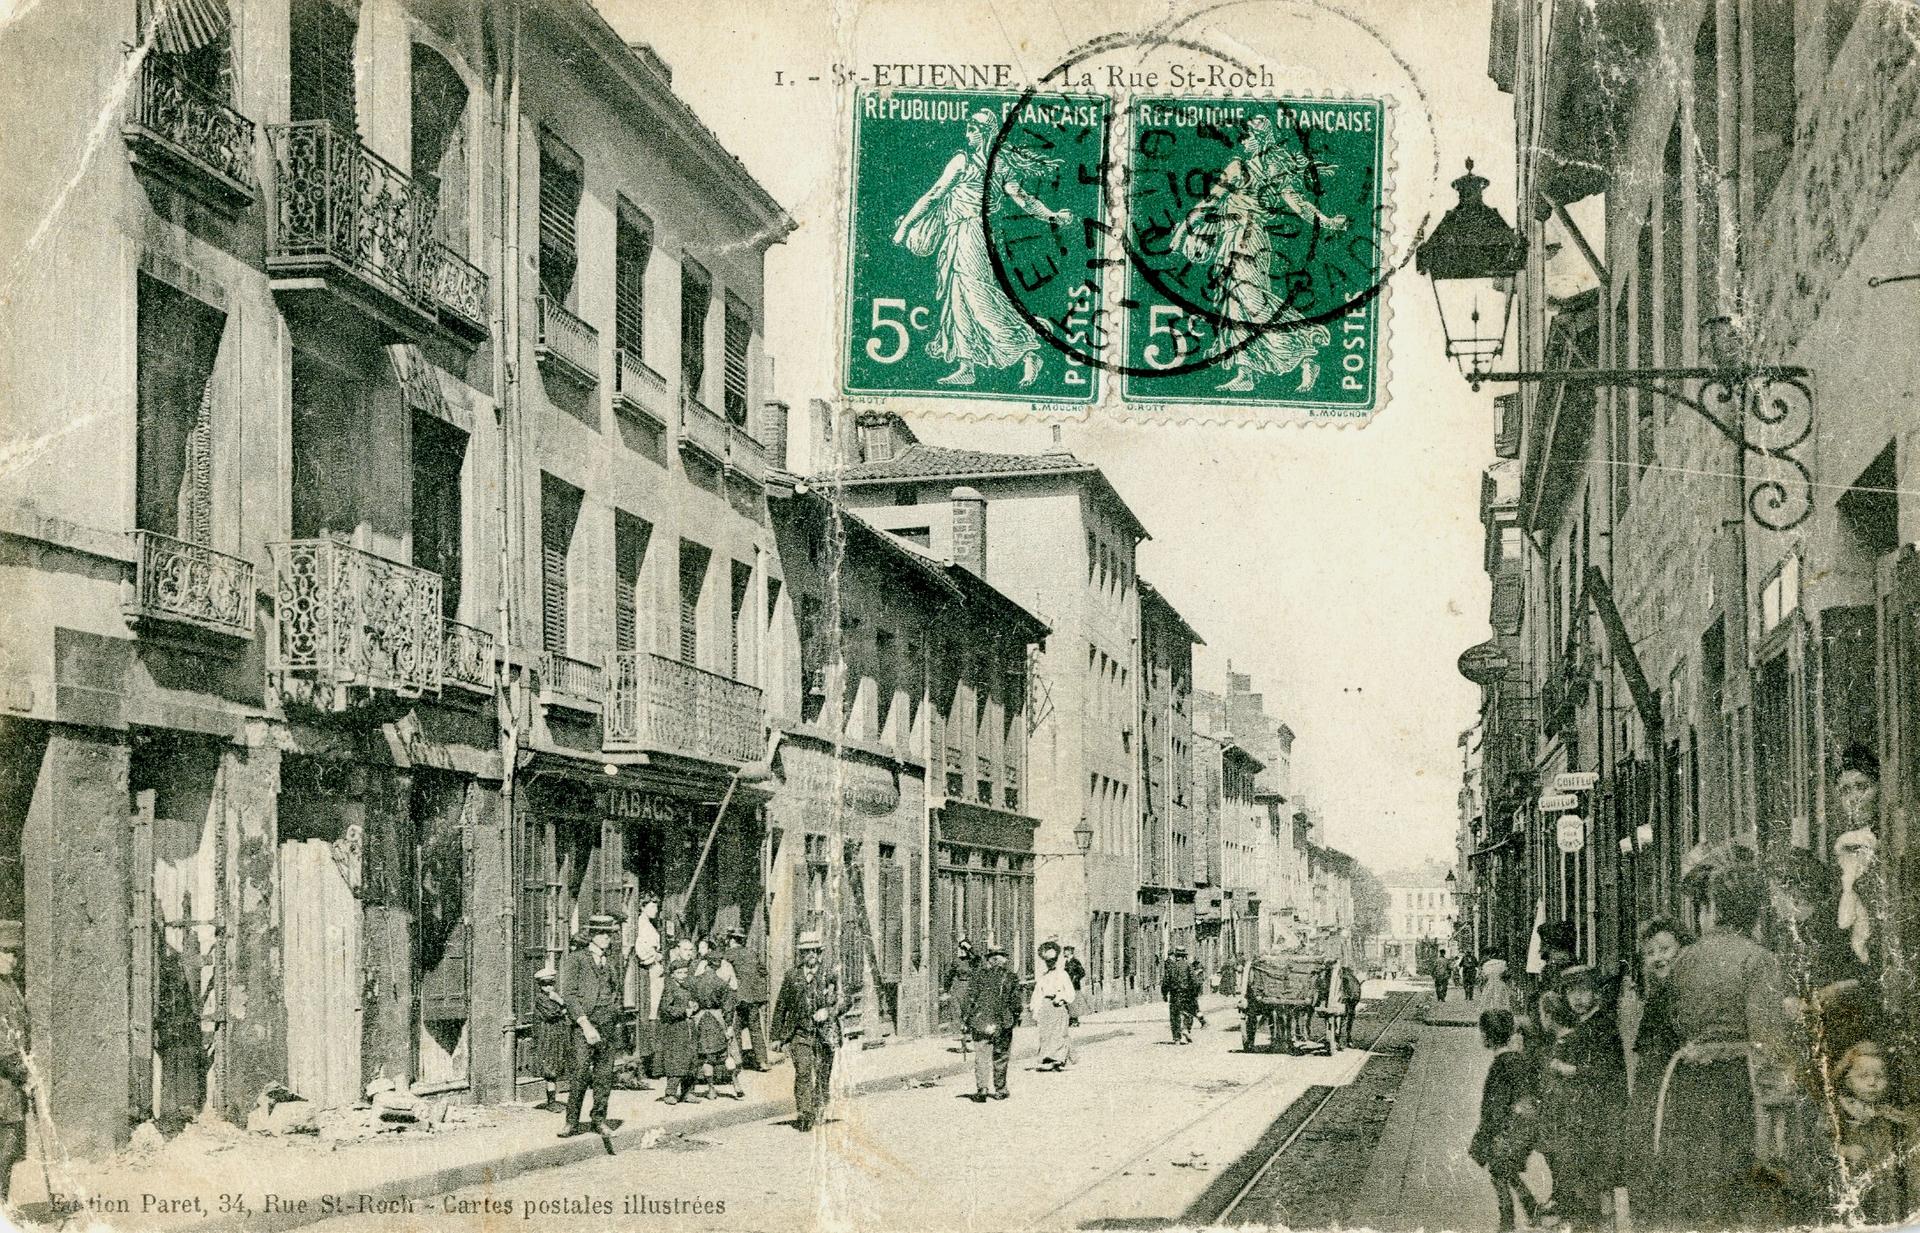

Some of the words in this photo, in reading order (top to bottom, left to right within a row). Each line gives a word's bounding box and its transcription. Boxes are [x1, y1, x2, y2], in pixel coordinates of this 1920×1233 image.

[1002, 102, 1098, 128] FRANÇAISE
[1276, 110, 1372, 133] FRANÇAISE
[1063, 283, 1092, 385] POSTES
[1341, 290, 1369, 391] POSTES
[608, 787, 675, 822] TABACS
